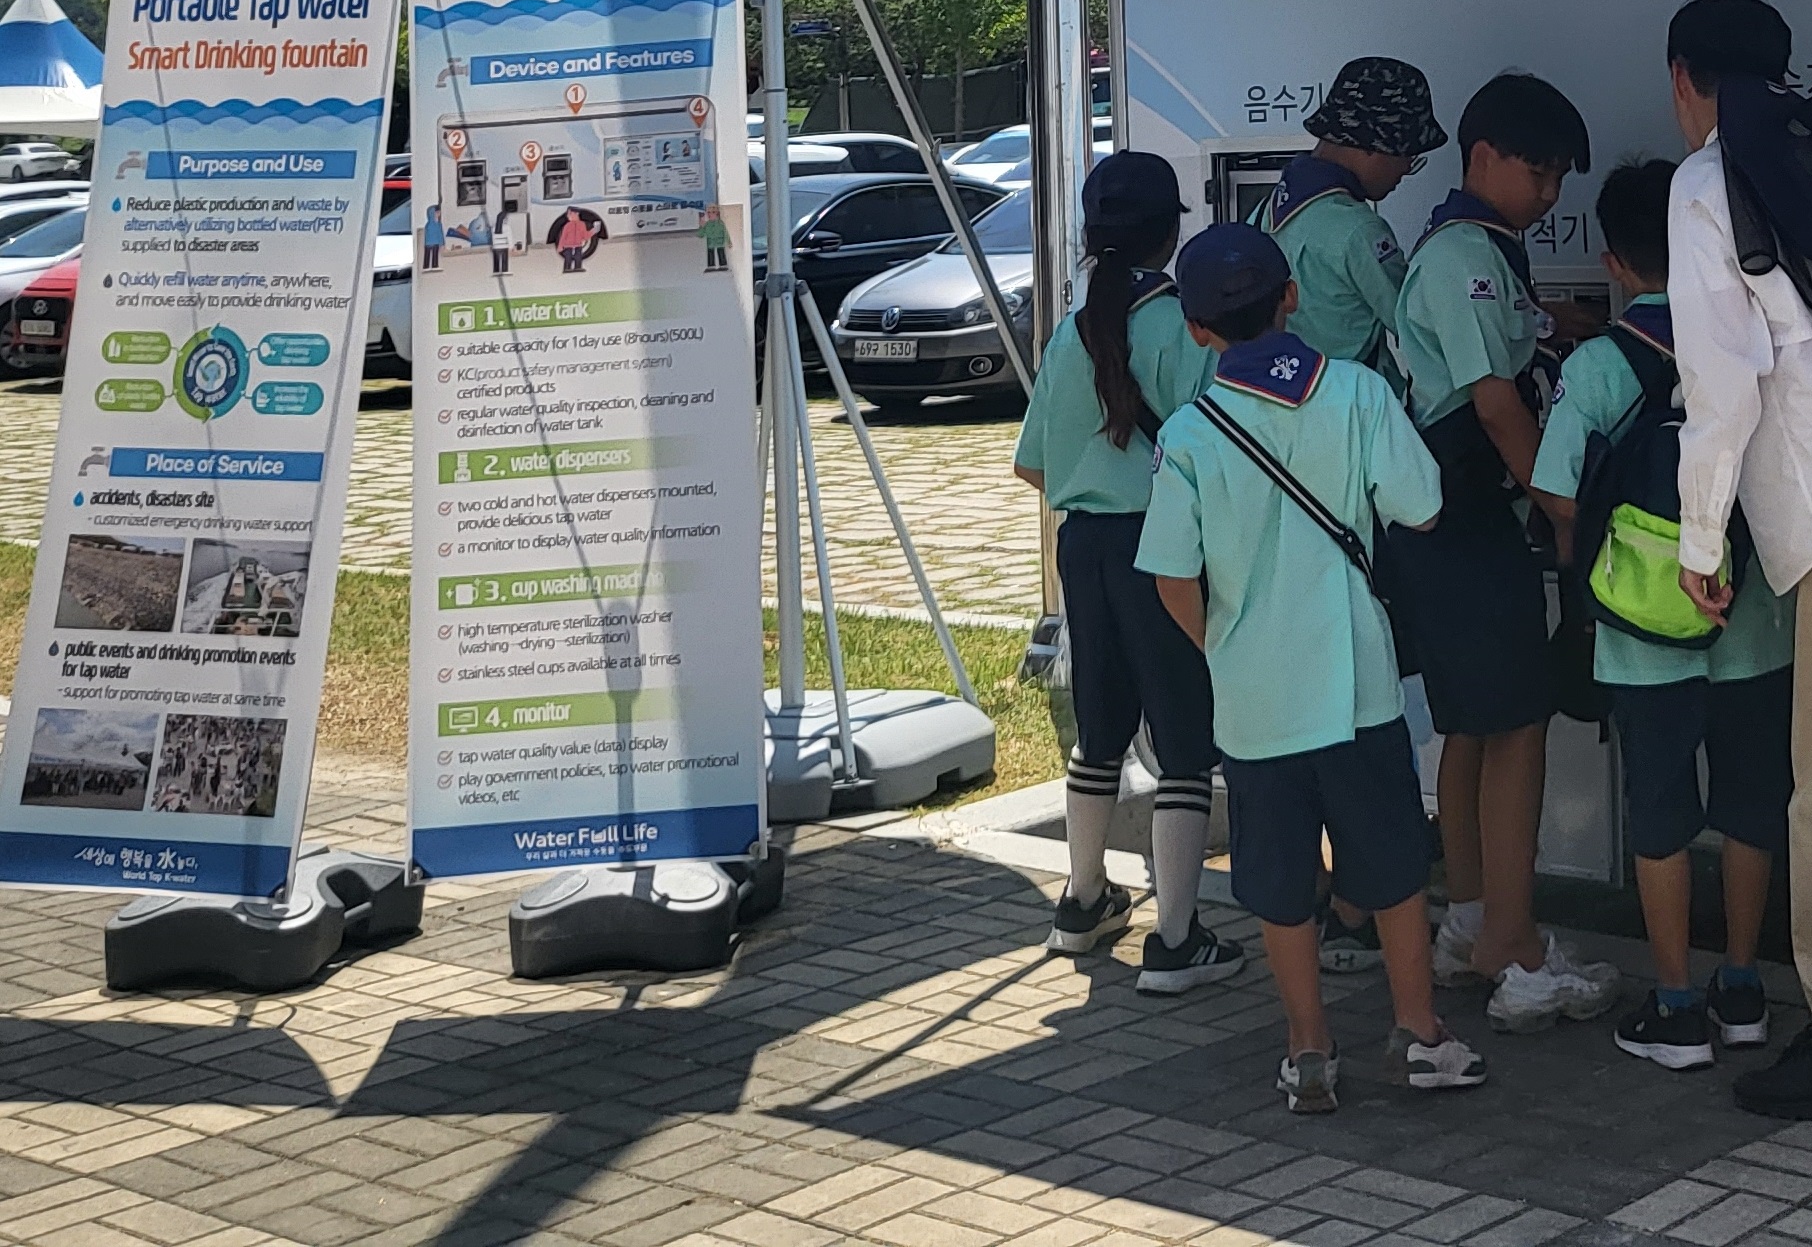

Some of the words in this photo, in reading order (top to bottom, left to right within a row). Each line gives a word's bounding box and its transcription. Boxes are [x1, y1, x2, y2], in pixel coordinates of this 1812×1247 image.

[128, 41, 190, 70] Smart
[195, 39, 276, 75] Drinking
[282, 38, 367, 68] fountain
[489, 58, 559, 79] Device
[563, 54, 601, 73] and
[606, 48, 694, 70] Features
[573, 88, 580, 100] 1
[693, 100, 705, 113] 4
[1244, 83, 1326, 123] 음수기
[453, 133, 462, 146] 2
[526, 146, 536, 158] 3
[180, 156, 249, 177] Purpose
[252, 155, 284, 172] and
[289, 155, 324, 172] Use
[127, 197, 171, 211] Reduce
[173, 198, 207, 213] plastic
[209, 197, 268, 213] production
[272, 197, 294, 210] and
[297, 200, 331, 211] waste
[334, 198, 349, 213] by
[483, 307, 505, 327] 1.
[510, 304, 552, 322] water
[555, 301, 589, 319] tank
[884, 343, 911, 356] 1530
[146, 453, 194, 472] Place
[200, 457, 215, 473] of
[218, 459, 285, 475] Service
[484, 454, 506, 476] 2.
[511, 454, 553, 472] water
[556, 449, 631, 471] dispensers
[458, 501, 481, 512] two
[511, 494, 534, 508] and
[560, 492, 595, 505] water
[597, 488, 655, 503] dispensers
[659, 482, 717, 498] mounted,
[458, 544, 465, 553] a
[468, 539, 515, 552] monitor
[518, 538, 530, 549] to
[575, 532, 609, 544] water
[652, 523, 720, 540] information
[484, 580, 507, 602] 3.
[511, 579, 539, 601] cup
[541, 573, 600, 597] washing
[458, 663, 505, 681] stainless
[508, 660, 535, 677] steel
[567, 654, 618, 672] available
[620, 655, 631, 668] at
[485, 709, 510, 729] 4.
[513, 702, 572, 725] monitor
[514, 831, 575, 850] Water
[578, 825, 618, 845] Full
[623, 823, 658, 841] Life
